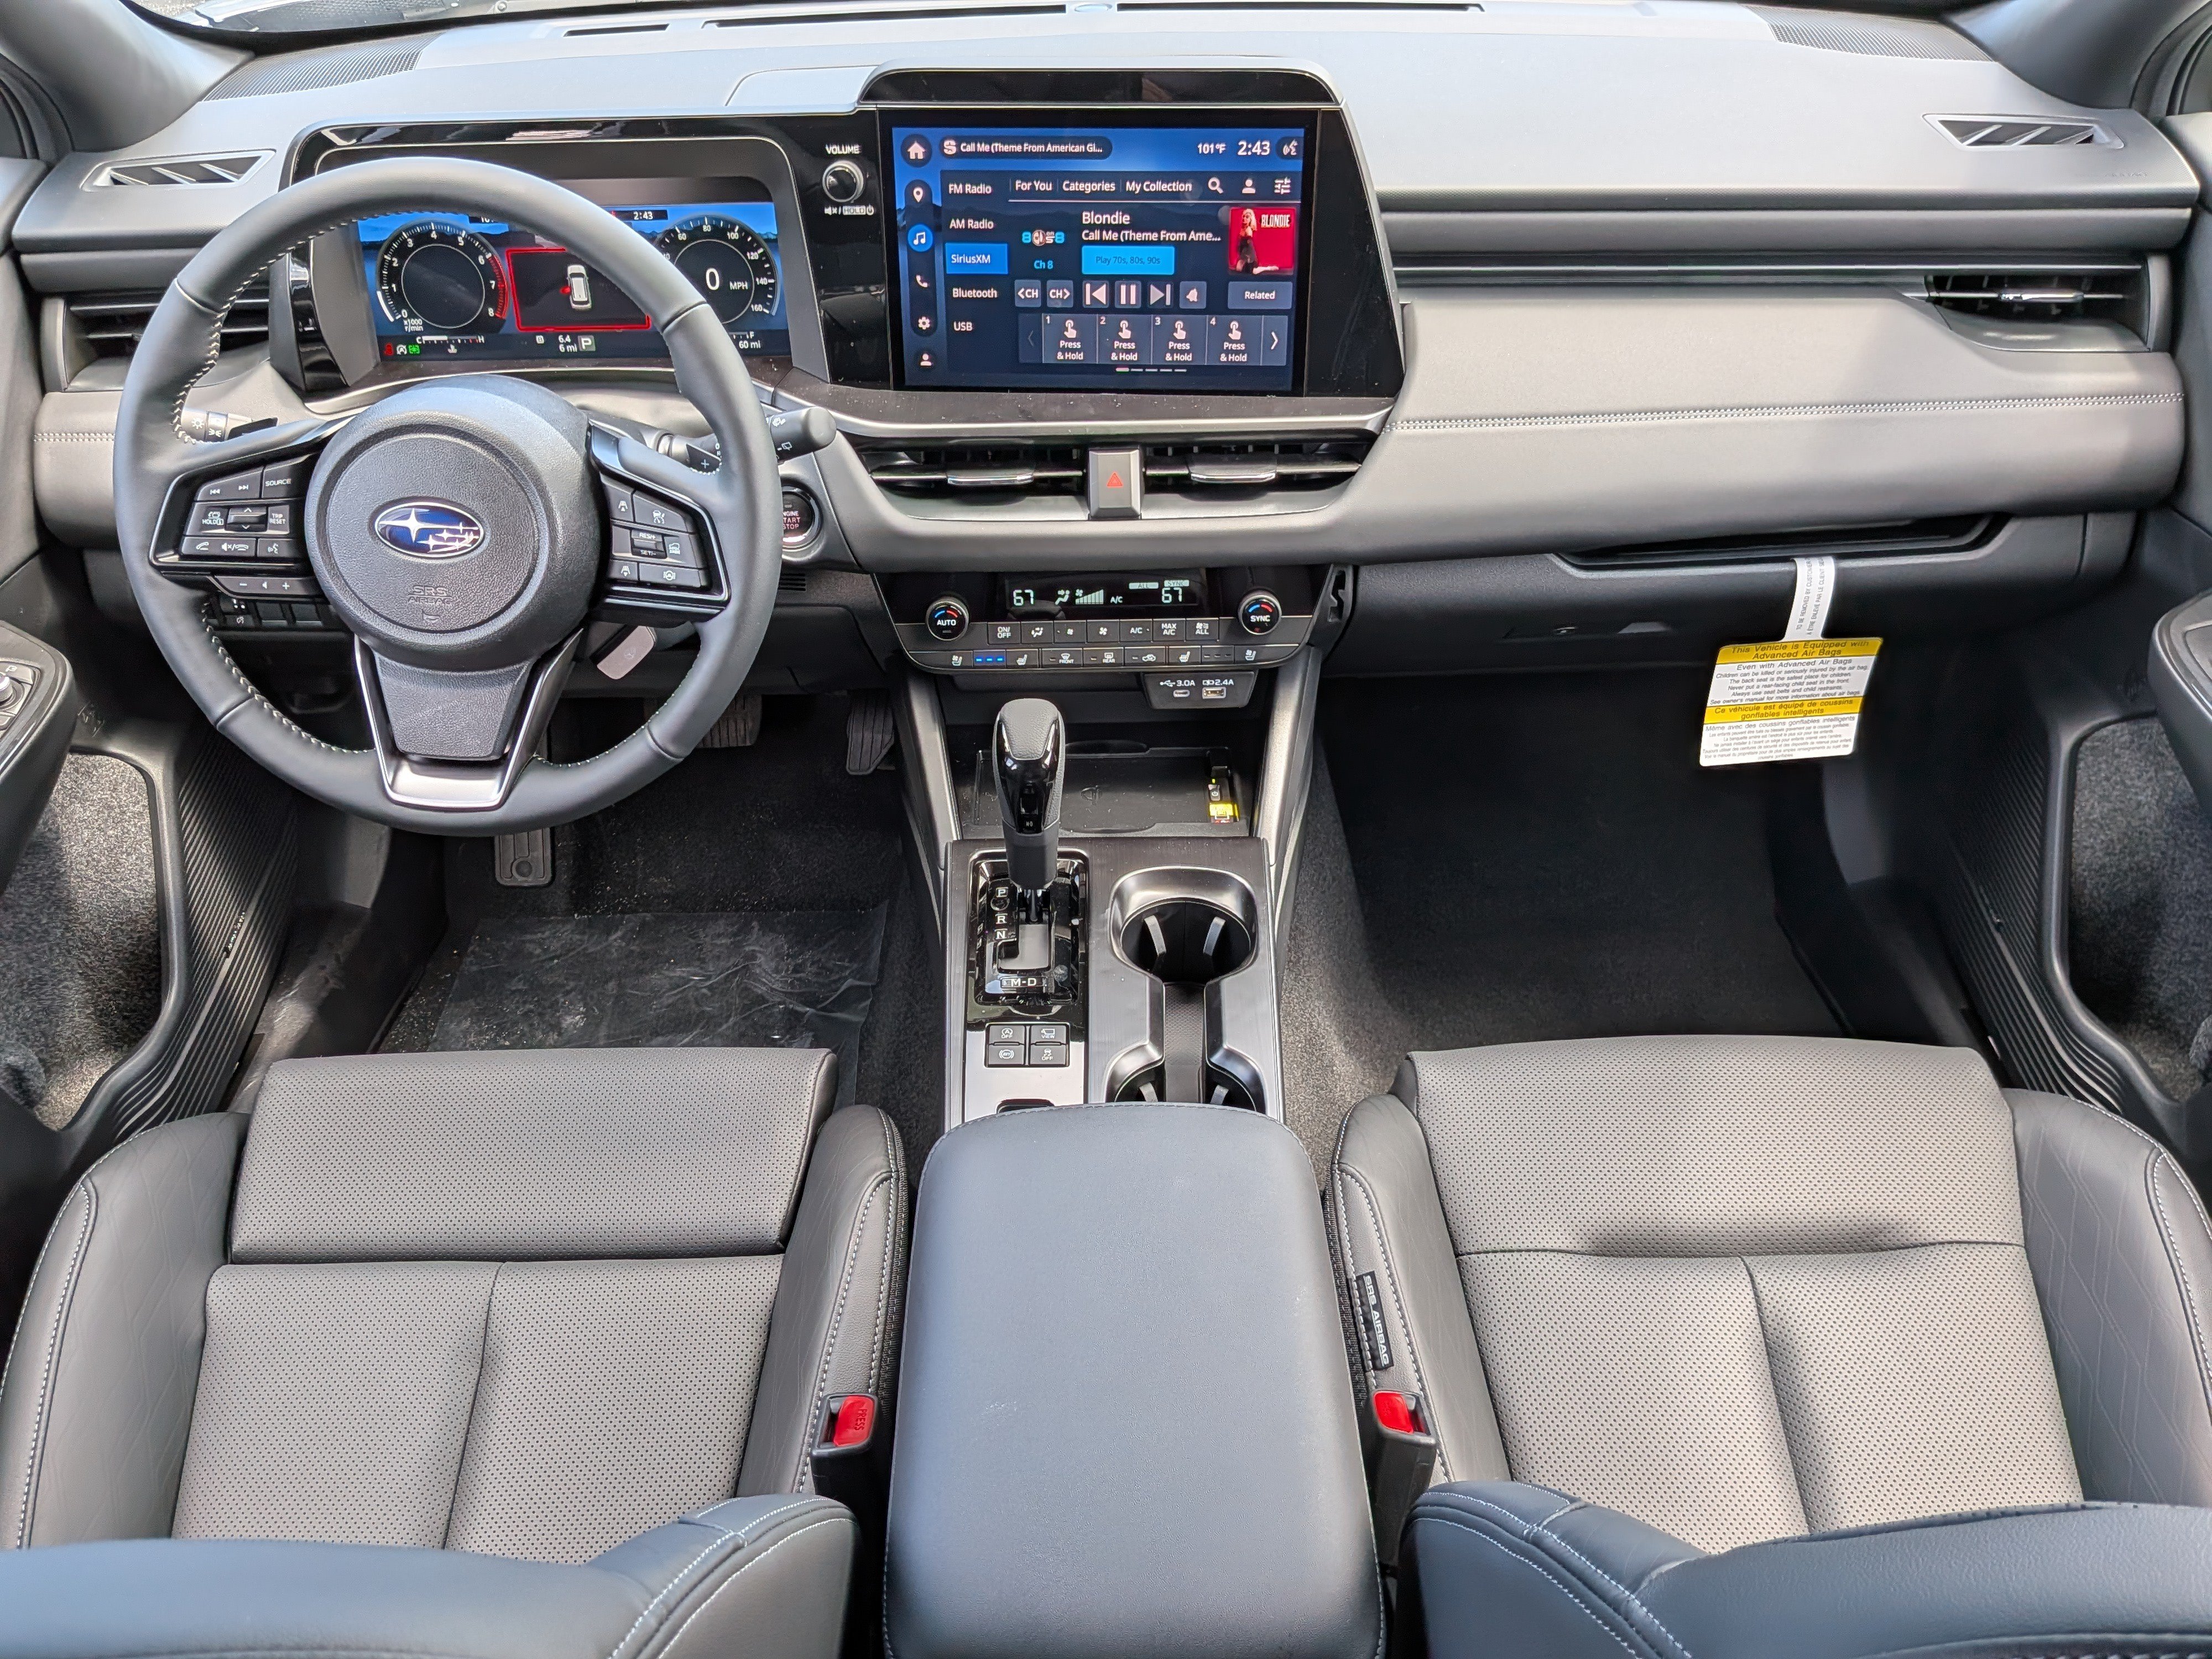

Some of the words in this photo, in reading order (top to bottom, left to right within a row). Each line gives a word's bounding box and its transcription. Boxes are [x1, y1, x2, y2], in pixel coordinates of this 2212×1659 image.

[825, 144, 860, 154] VOLUME
[961, 142, 975, 152] Call
[977, 143, 990, 152] Me
[991, 143, 1022, 153] (Theme
[1024, 143, 1045, 153] From
[1046, 143, 1084, 153] American
[1237, 140, 1271, 156] 2:43
[949, 183, 962, 194] FM
[965, 183, 992, 195] Radio
[1015, 180, 1031, 191] For
[1033, 180, 1052, 191] You
[1062, 180, 1116, 194] Categories
[1125, 181, 1141, 194] My
[1143, 180, 1192, 192] Collection
[844, 206, 865, 215] HOLD
[633, 211, 653, 220] 2:43
[1082, 211, 1131, 225] Blondie
[950, 219, 966, 229] AM
[968, 218, 994, 230] Radio
[1260, 214, 1291, 228] BLONDIE
[430, 231, 437, 239] 4
[1082, 229, 1100, 241] Call
[1103, 230, 1119, 241] Me
[1120, 230, 1159, 242] (Theme
[1160, 231, 1187, 242] From
[407, 238, 414, 247] 3
[458, 237, 464, 246] 5
[392, 258, 399, 267] 2
[478, 255, 485, 264] 6
[951, 254, 991, 264] SiriusXM
[1095, 257, 1111, 266] Play
[1113, 256, 1128, 265] 70s,
[1130, 257, 1145, 266] 80s,
[1034, 259, 1046, 269] Ch
[1047, 259, 1053, 269] 8
[706, 268, 719, 290] 0
[392, 284, 397, 292] 1
[489, 280, 495, 289] 7
[729, 281, 748, 290] MPH
[952, 288, 998, 299] Bluetooth
[1244, 290, 1275, 300] Related
[488, 308, 494, 316] 8
[751, 304, 763, 312] 160
[401, 310, 408, 318] 0
[1046, 316, 1051, 324] 1
[1099, 316, 1106, 325] 2
[1155, 316, 1161, 325] 3
[1210, 317, 1216, 325] 4
[953, 322, 973, 331] USB
[478, 335, 484, 343] H
[559, 335, 571, 343] 6.4
[581, 338, 592, 349] P
[559, 344, 565, 352] 6
[567, 343, 577, 352] mi
[739, 341, 748, 349] 60
[750, 340, 761, 348] mi
[1060, 340, 1081, 349] Press
[1114, 341, 1135, 349] Press
[1168, 342, 1190, 350] Press
[1224, 342, 1245, 351] Press
[1057, 352, 1063, 360] &
[1065, 352, 1083, 360] Hold
[1119, 353, 1138, 361] Hold
[1228, 354, 1247, 362] Hold
[265, 478, 291, 487] SOURCE
[413, 585, 447, 597] SRS
[1162, 587, 1182, 603] 67
[408, 597, 452, 605] AIRBAG
[1013, 589, 1034, 606] 67
[1110, 596, 1123, 604] A/C
[1755, 644, 1787, 652] Vehicle
[1803, 641, 1846, 649] Equipped
[1752, 651, 1798, 660] Advanced
[1818, 649, 1841, 657] Bags
[1741, 711, 1780, 721] gonflables
[997, 931, 1005, 939] N
[1364, 1275, 1377, 1305] SRS
[1373, 1310, 1390, 1366] AIRBAG
[854, 1408, 868, 1431] PRESS
